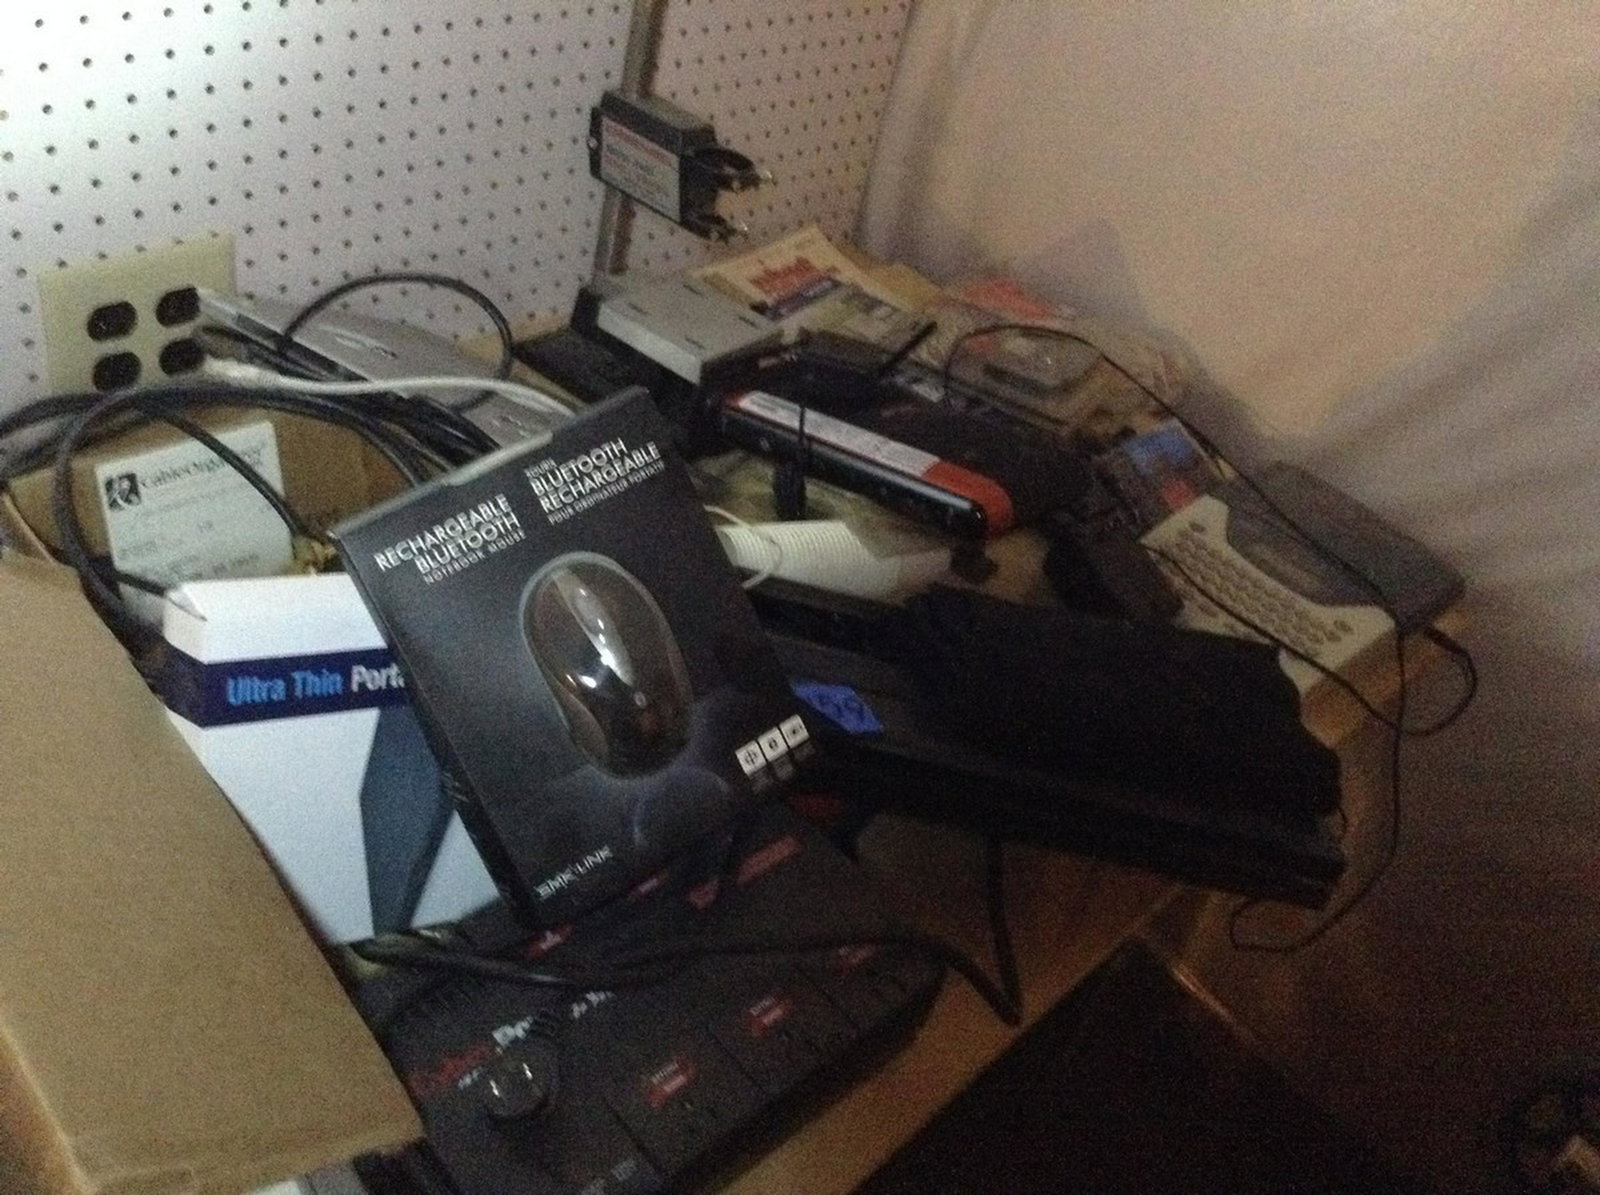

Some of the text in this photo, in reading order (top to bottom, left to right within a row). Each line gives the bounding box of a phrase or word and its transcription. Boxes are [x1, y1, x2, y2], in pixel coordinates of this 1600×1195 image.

[530, 437, 628, 497] BLUETOOTH
[538, 441, 662, 513] RECHARGEABLE
[374, 493, 512, 572] RECHARGEABLE
[413, 511, 520, 574] BLUETOOTH
[423, 528, 526, 584] NOTEBOOK MOUSE
[227, 676, 286, 706] Ultra
[290, 668, 344, 698] Thin
